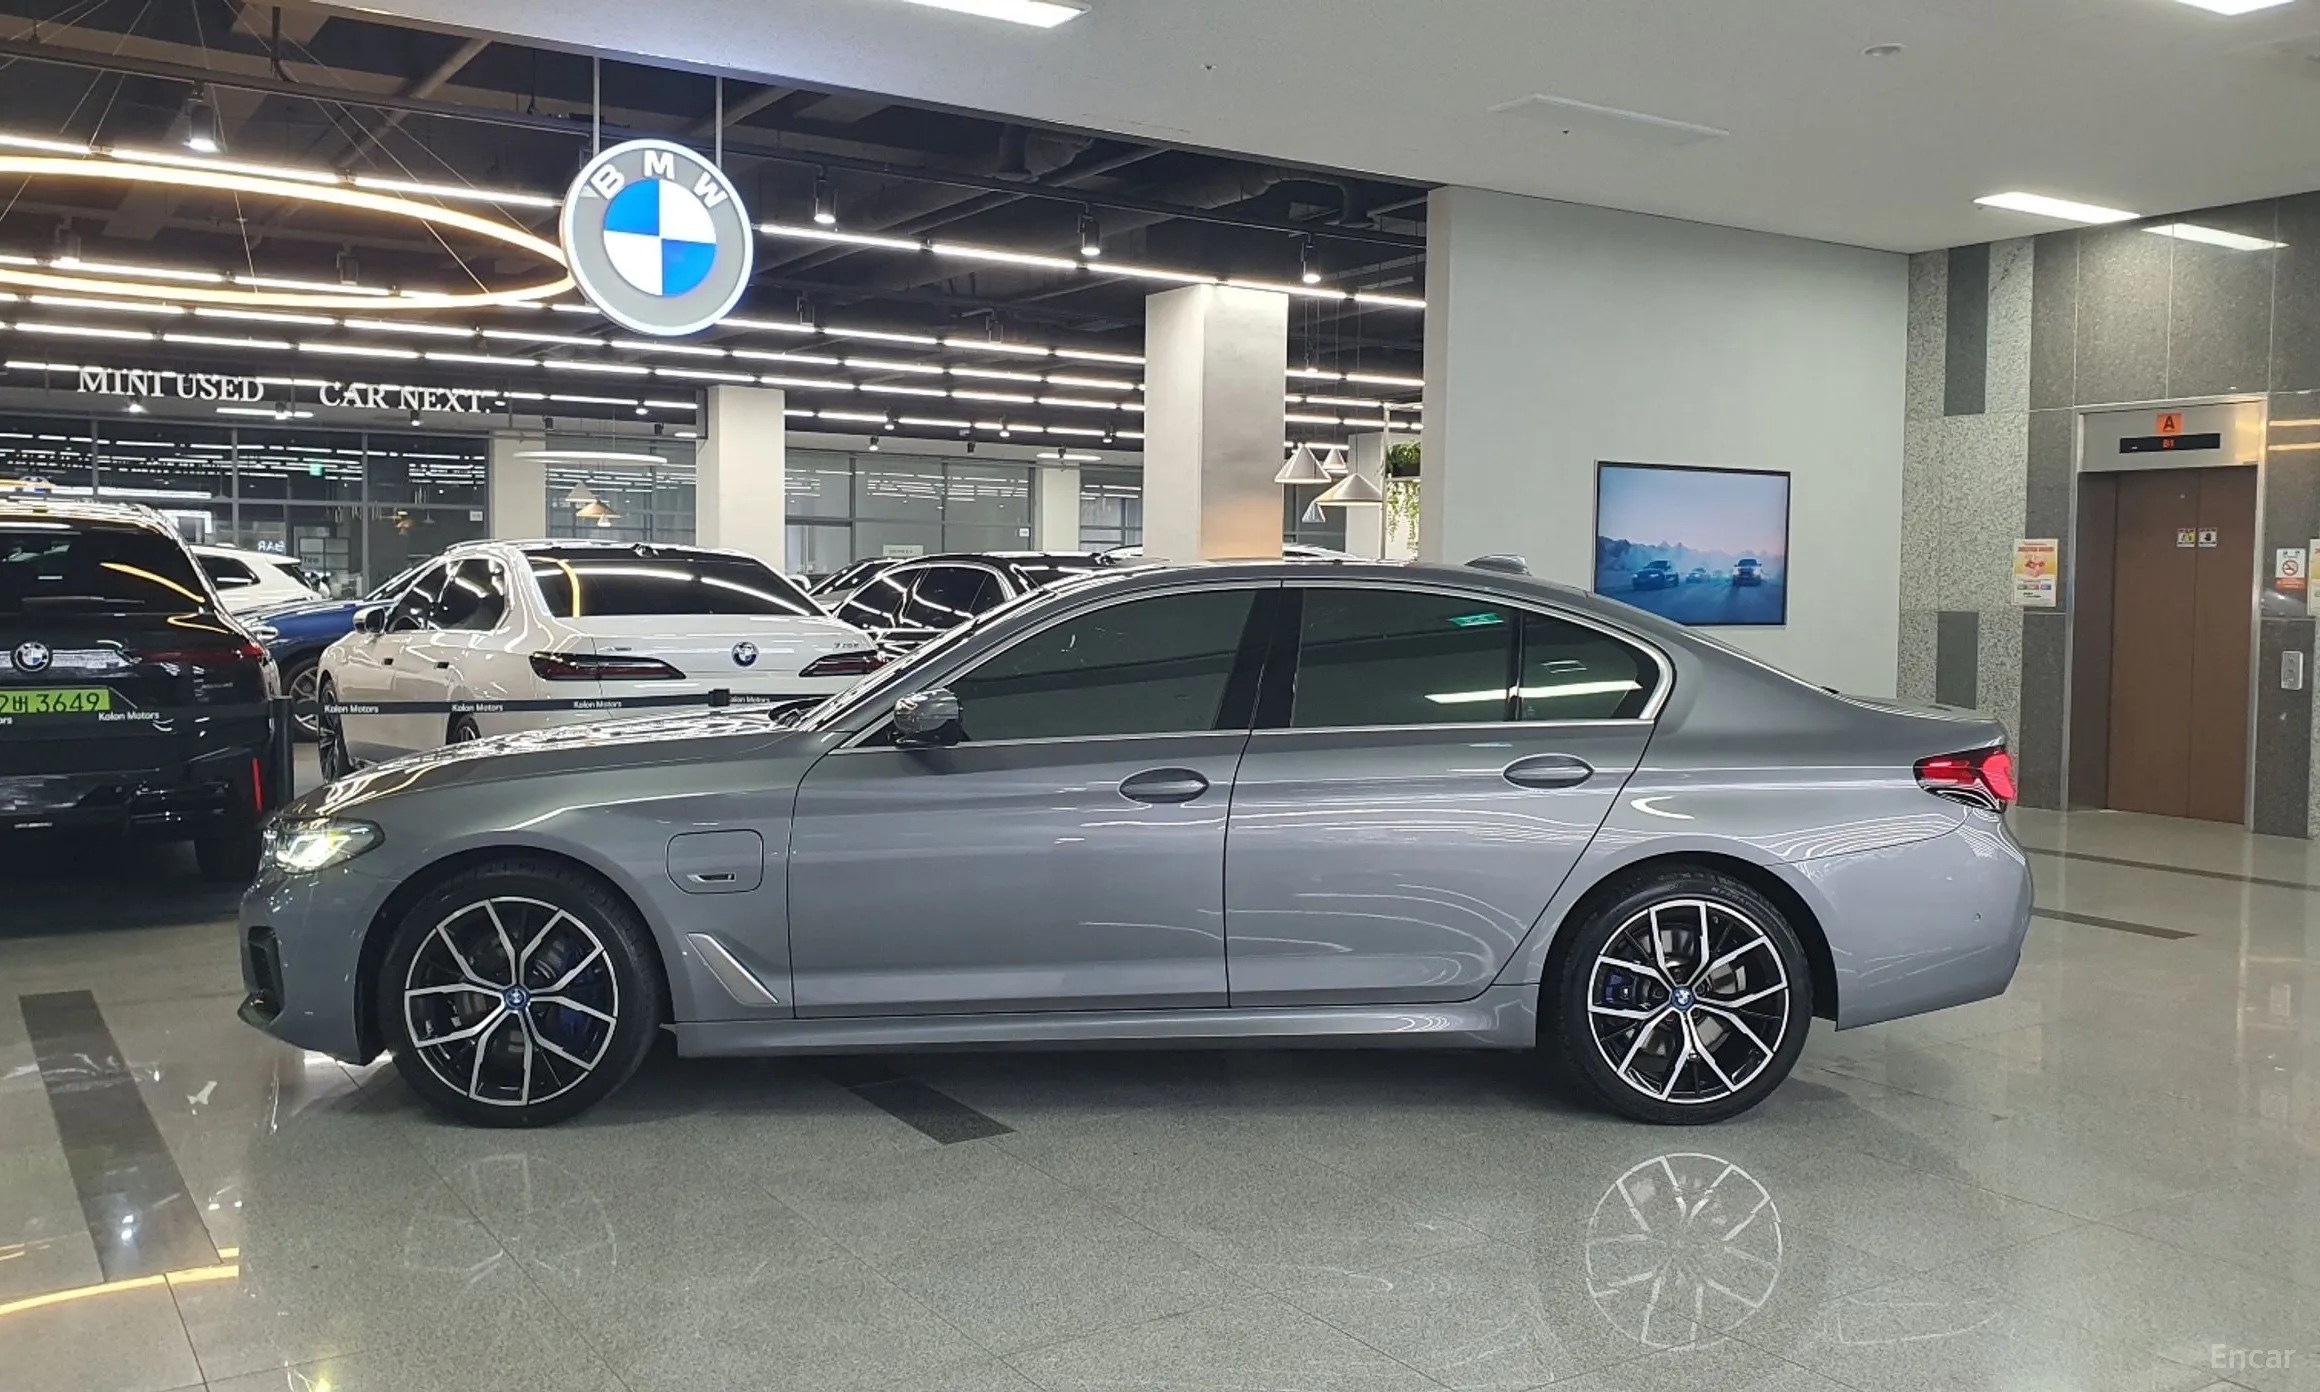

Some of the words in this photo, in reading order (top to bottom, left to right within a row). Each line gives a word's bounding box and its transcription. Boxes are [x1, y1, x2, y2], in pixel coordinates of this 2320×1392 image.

[591, 150, 729, 208] BMW
[77, 370, 164, 397] MINI
[175, 374, 264, 402] USED
[319, 384, 389, 409] CAR
[2162, 415, 2176, 433] A
[36, 692, 100, 713] 3649
[324, 704, 348, 713] Kolon
[350, 704, 379, 713] Motors
[452, 703, 475, 712] Kolon
[476, 703, 504, 711] Motors
[573, 701, 595, 709] Kolon
[596, 700, 622, 708] Motors
[98, 711, 125, 721] Kolon
[127, 710, 160, 720] Motors
